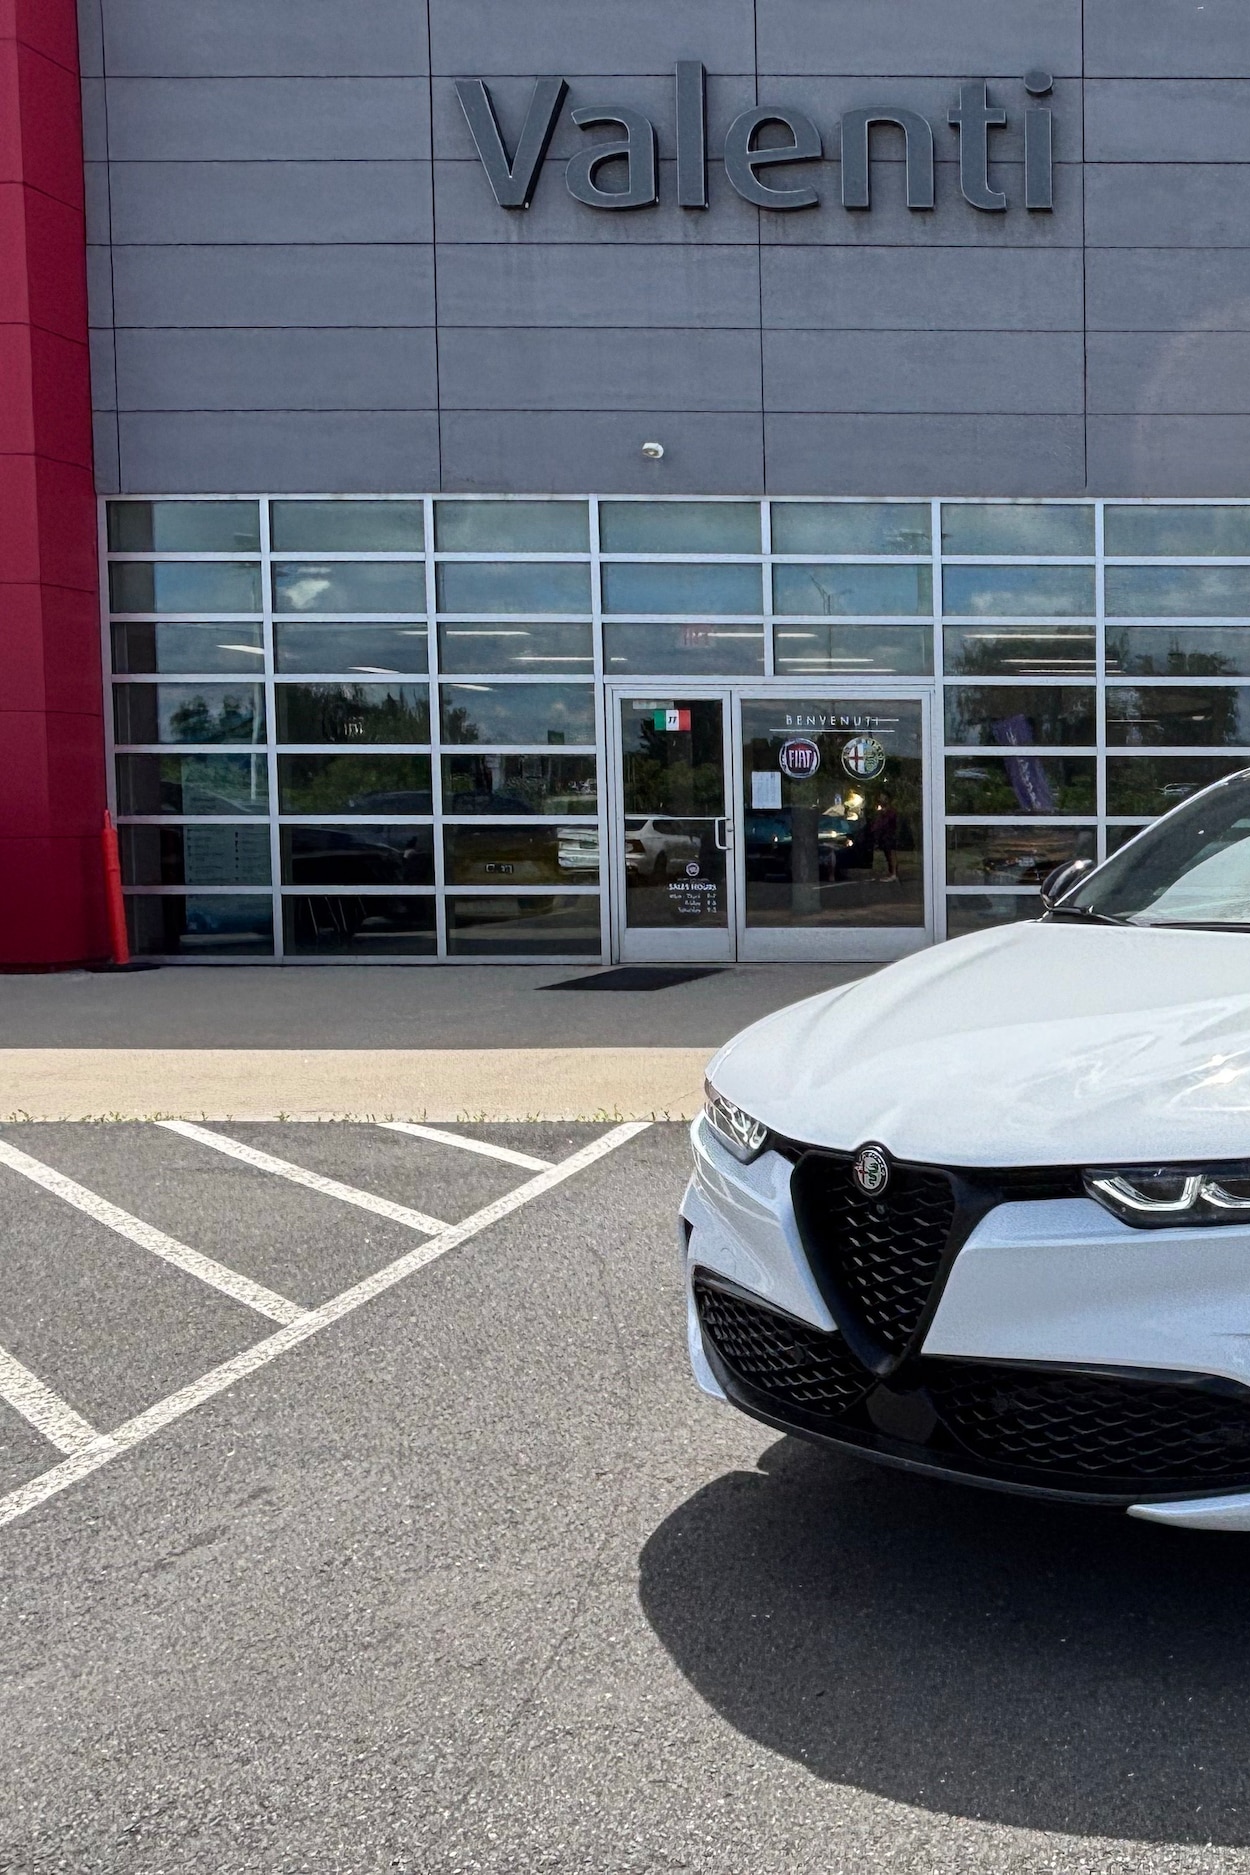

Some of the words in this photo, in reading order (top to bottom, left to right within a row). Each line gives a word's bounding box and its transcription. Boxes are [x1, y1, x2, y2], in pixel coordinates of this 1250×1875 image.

[454, 60, 1054, 211] Valenti
[785, 714, 880, 727] BENVENUTI
[788, 749, 813, 769] FIAT
